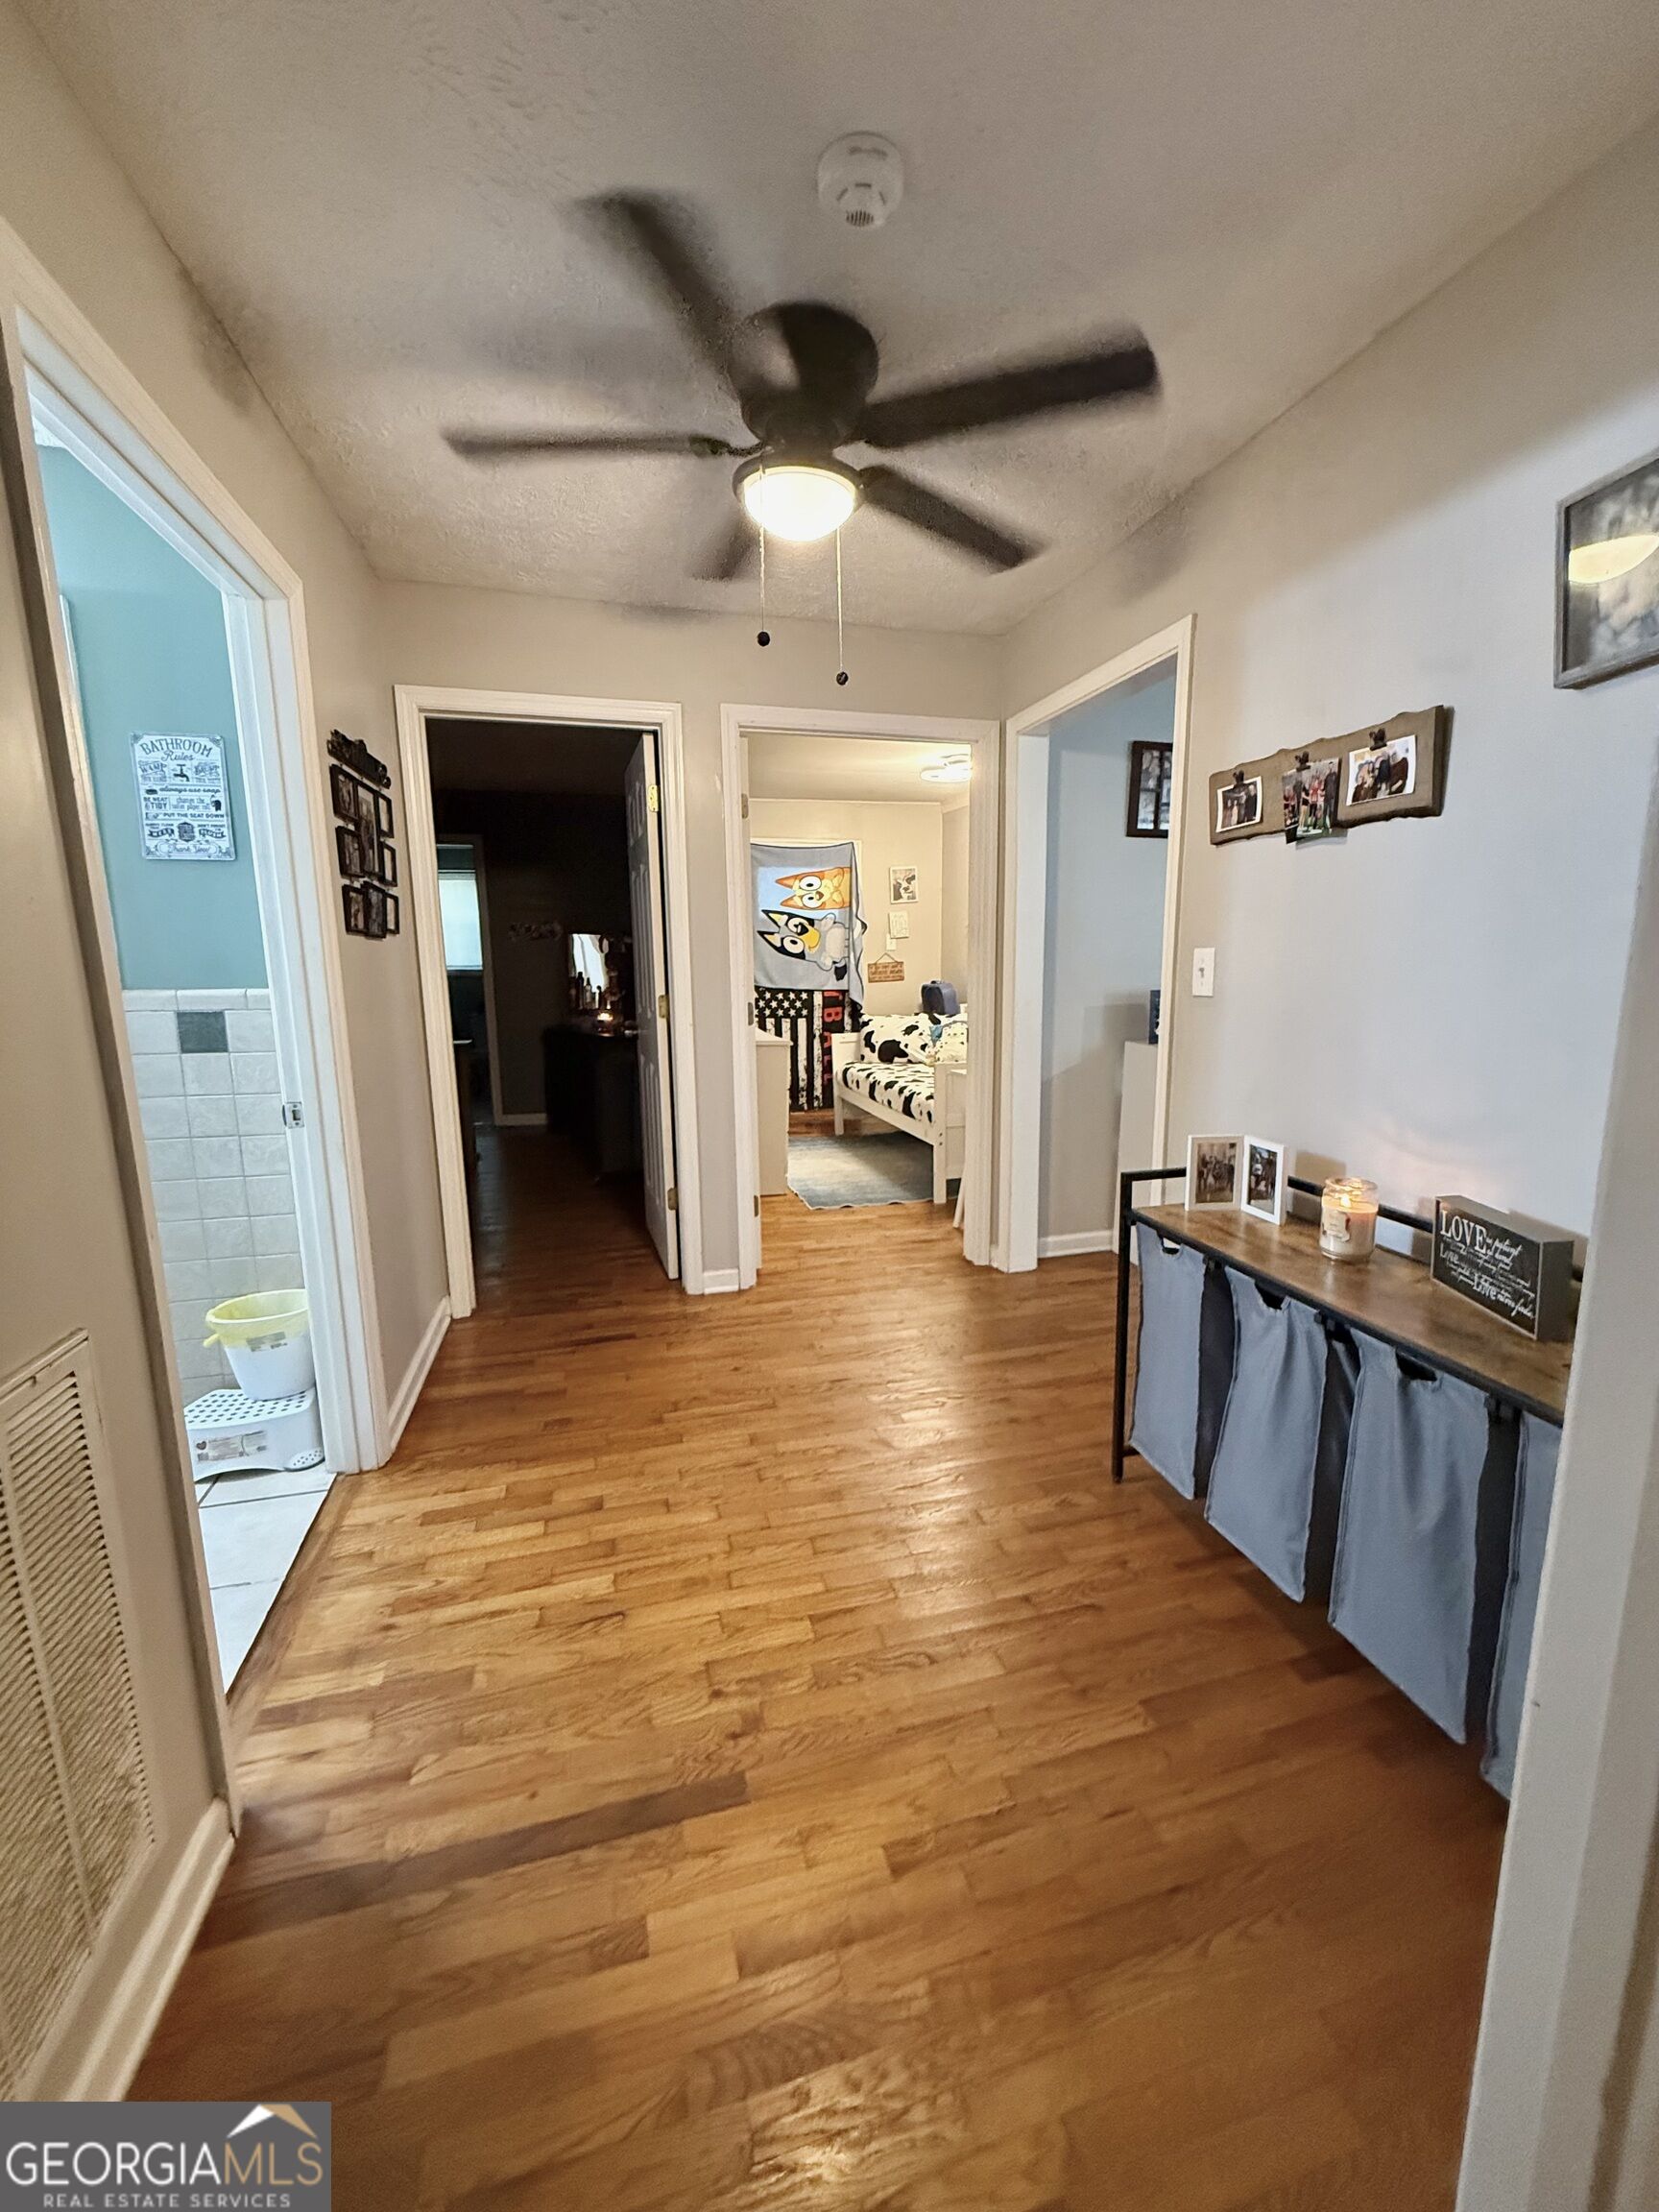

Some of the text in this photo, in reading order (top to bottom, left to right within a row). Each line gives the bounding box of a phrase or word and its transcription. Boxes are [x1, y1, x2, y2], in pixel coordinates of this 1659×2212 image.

[139, 737, 213, 757] BATHROOM
[161, 750, 194, 761] Rules
[1440, 1210, 1487, 1254] LOVE
